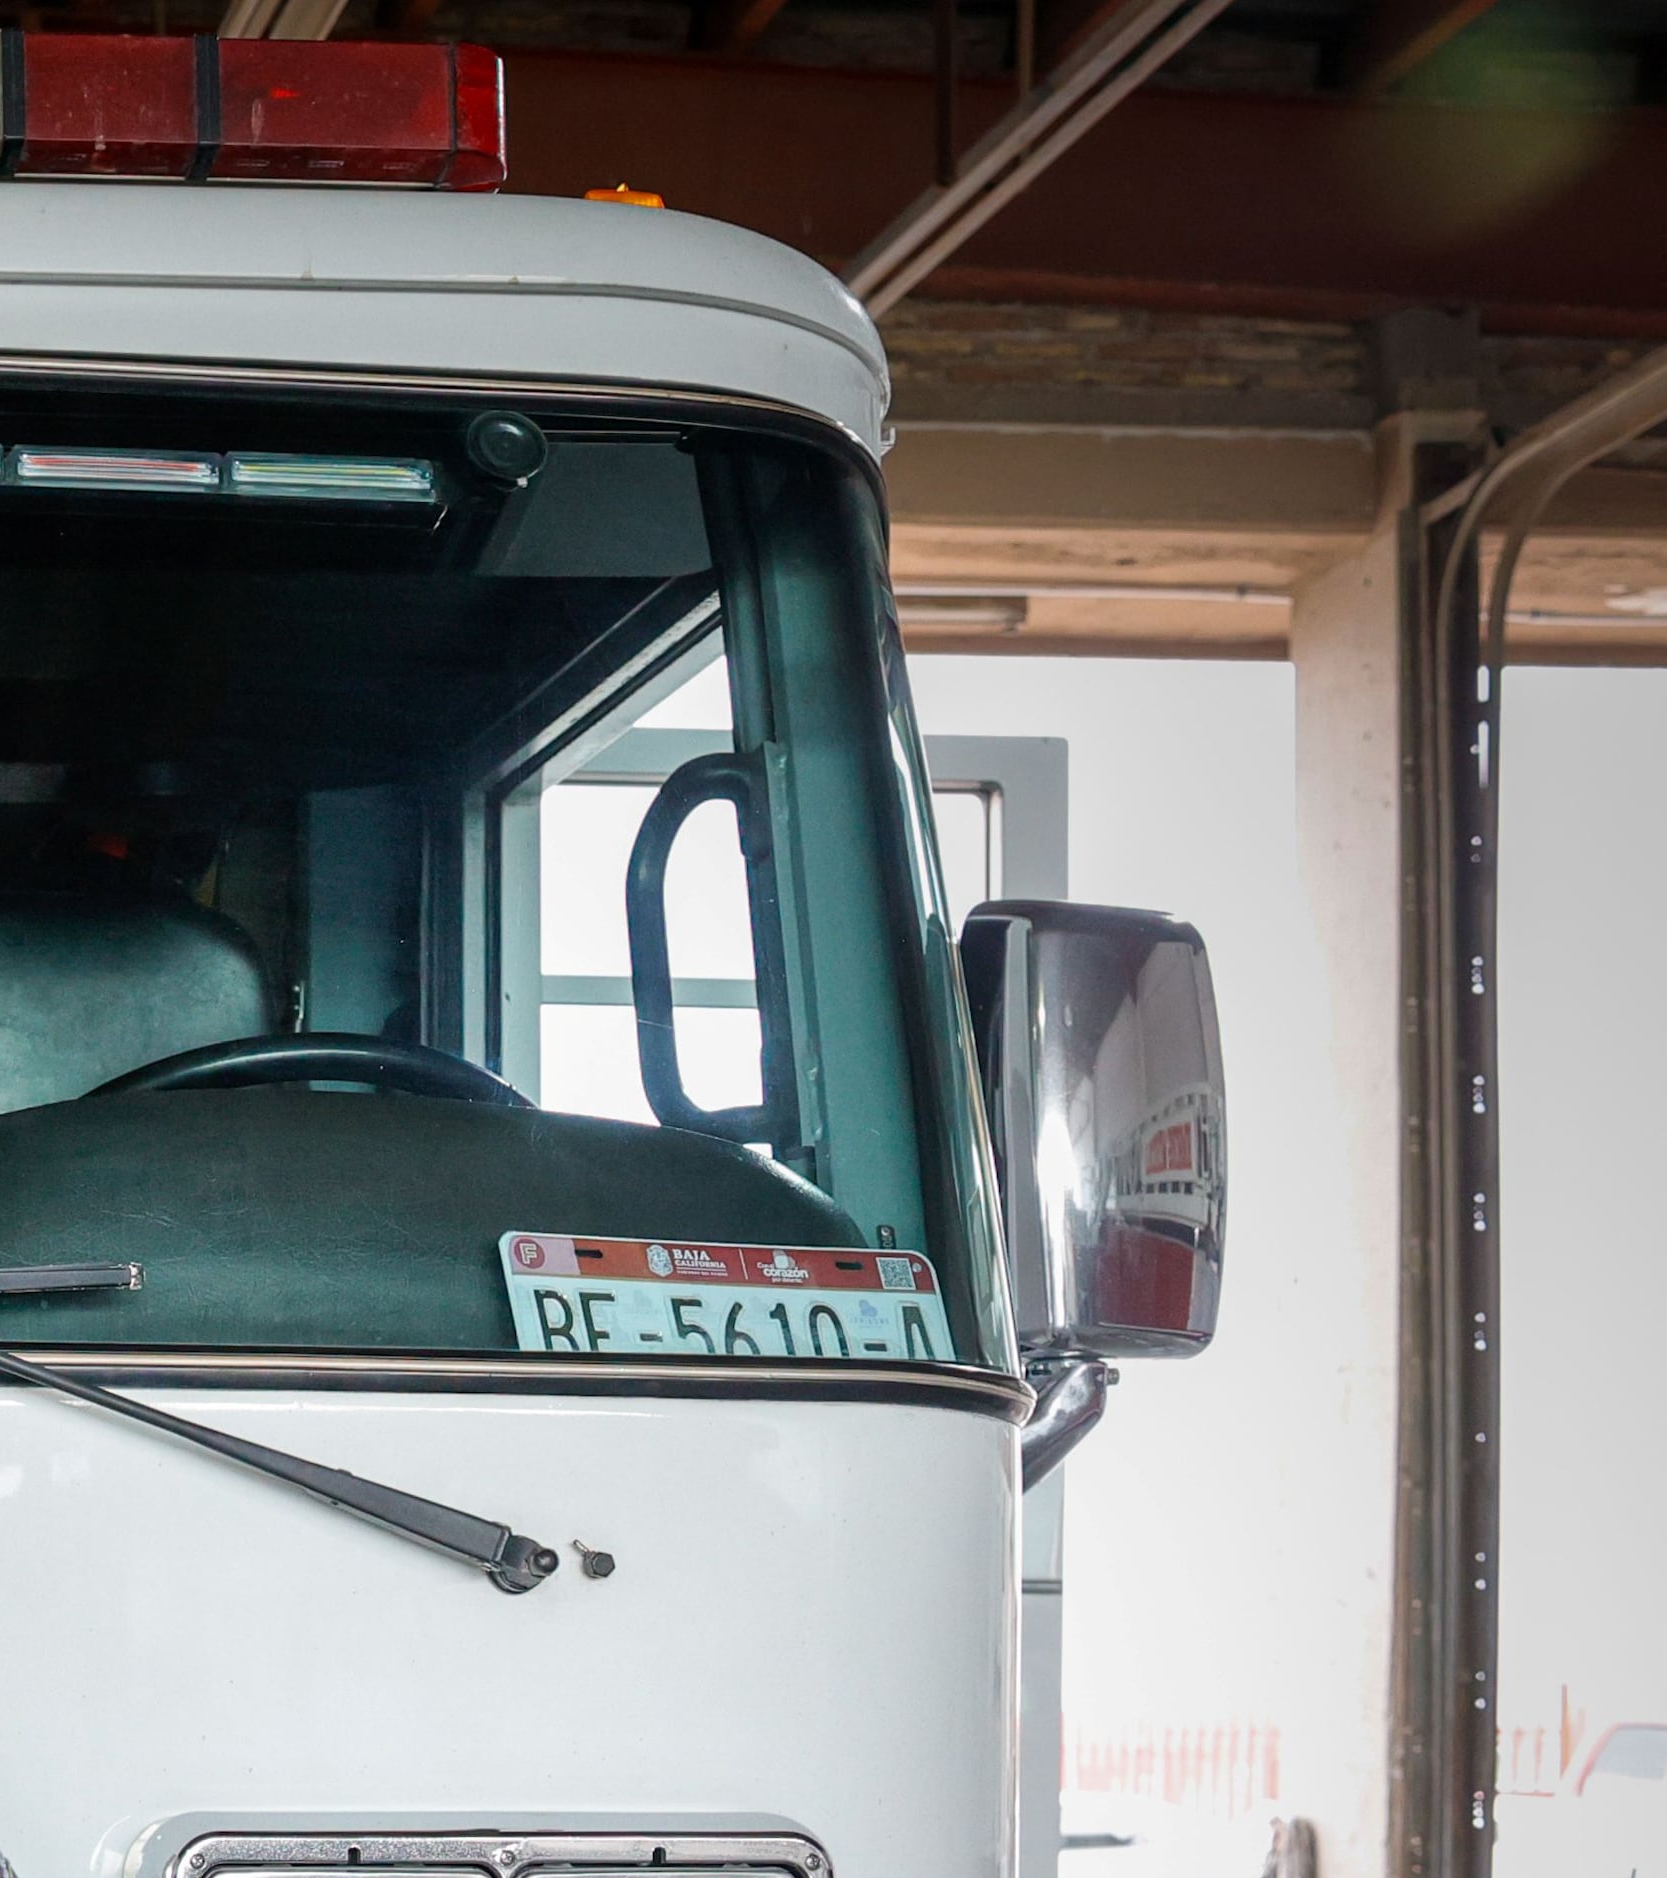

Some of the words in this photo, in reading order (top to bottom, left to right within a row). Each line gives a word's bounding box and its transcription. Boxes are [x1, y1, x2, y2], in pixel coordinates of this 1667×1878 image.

[519, 1242, 538, 1264] F
[672, 1248, 710, 1260] BAJA
[674, 1259, 726, 1269] CALIFORNIA
[763, 1266, 808, 1278] corazón
